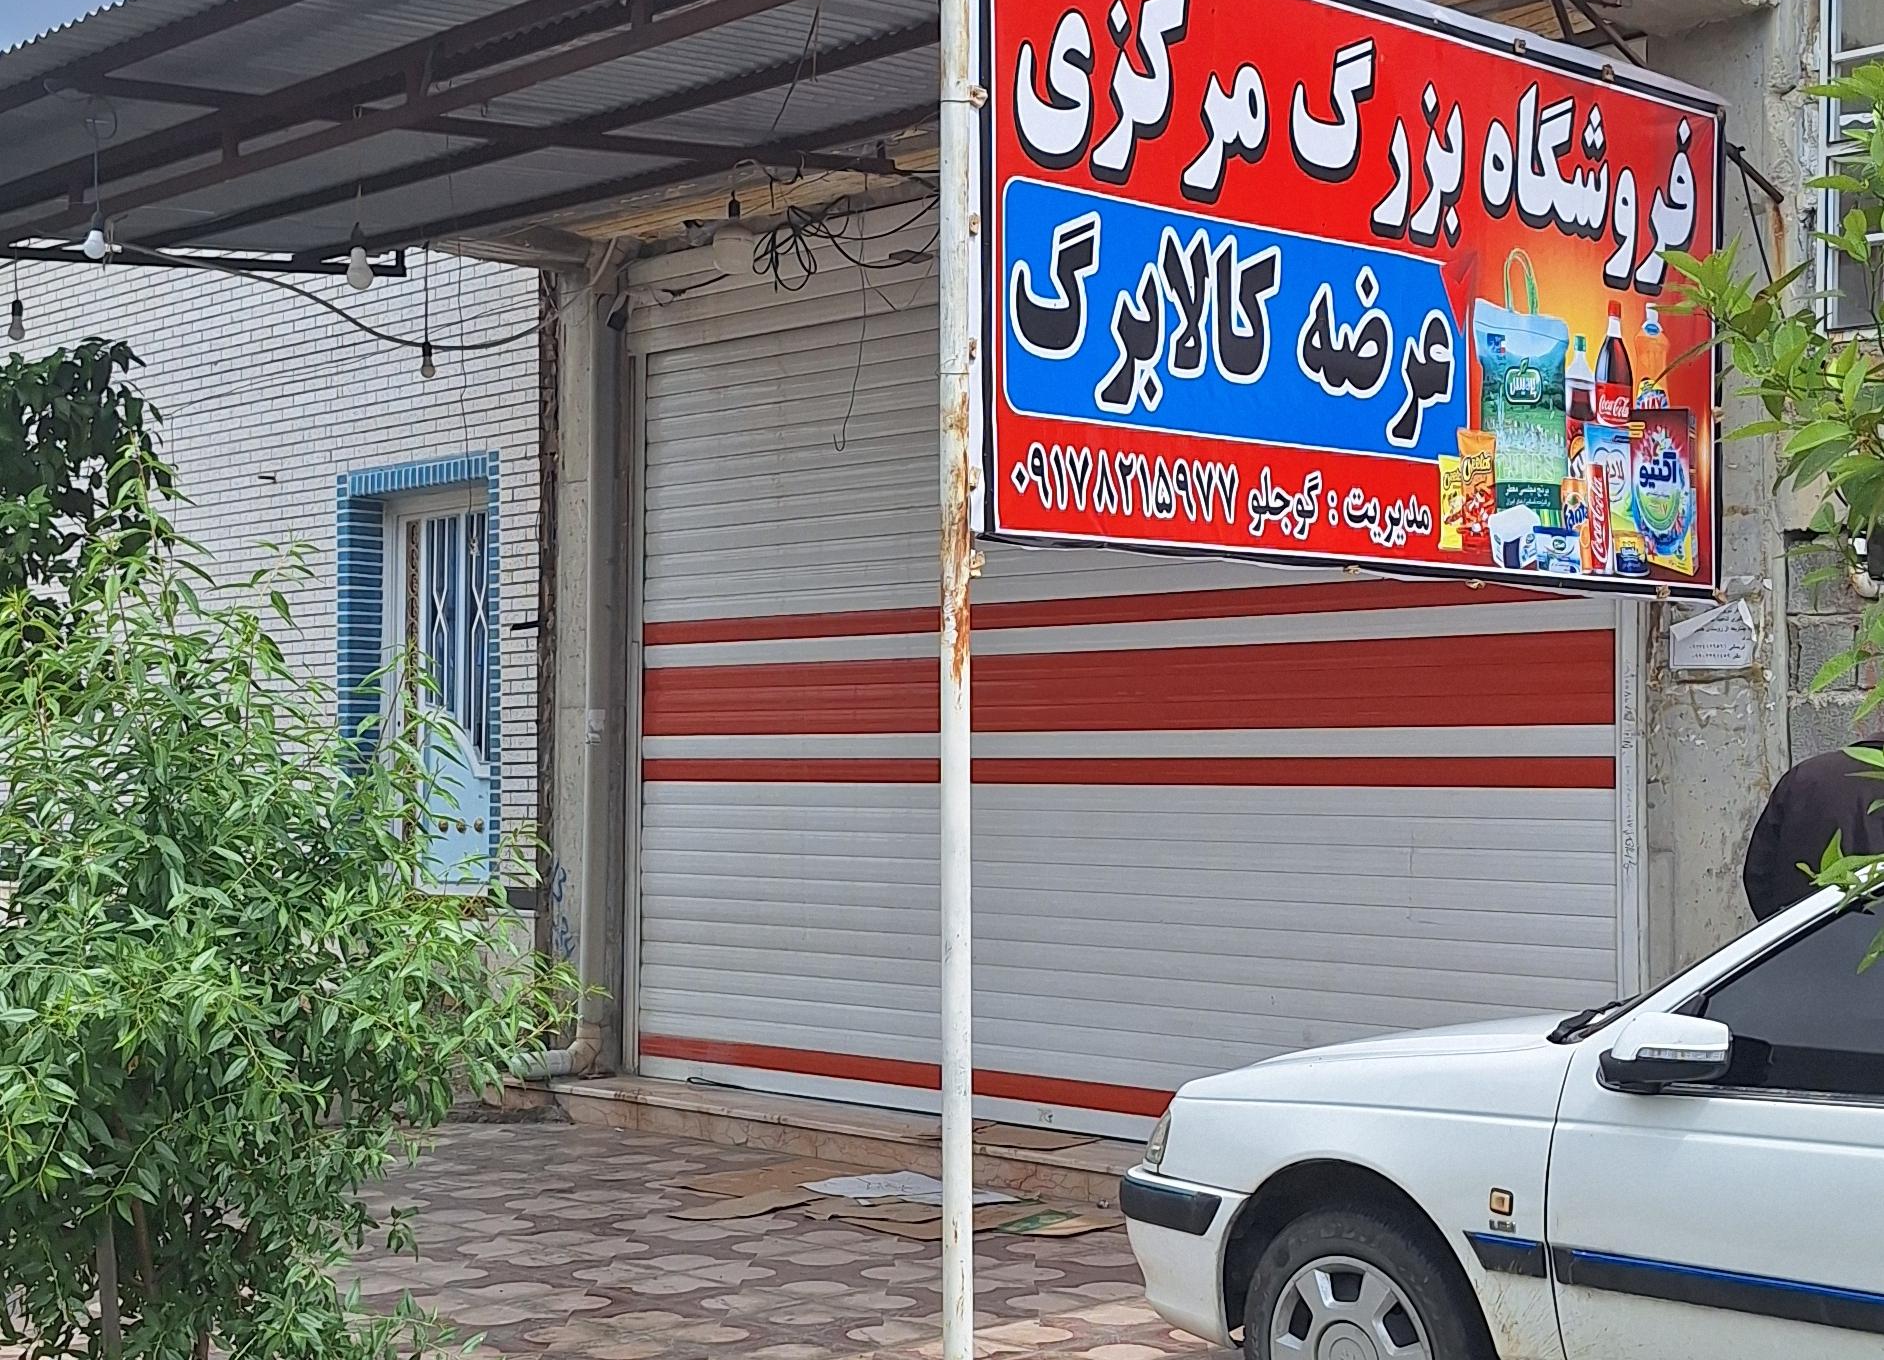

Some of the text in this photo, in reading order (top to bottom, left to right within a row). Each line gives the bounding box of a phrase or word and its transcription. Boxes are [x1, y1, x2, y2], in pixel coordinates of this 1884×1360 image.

[1289, 36, 1466, 248] بزرگ
[1481, 80, 1697, 297] فروشگاه
[1010, 211, 1454, 448] عرضه کالابرگ
[1011, 441, 1239, 524] ۰۹۱۷۸۲۱۵۹۷۷
[1343, 487, 1432, 547] مدیریت
